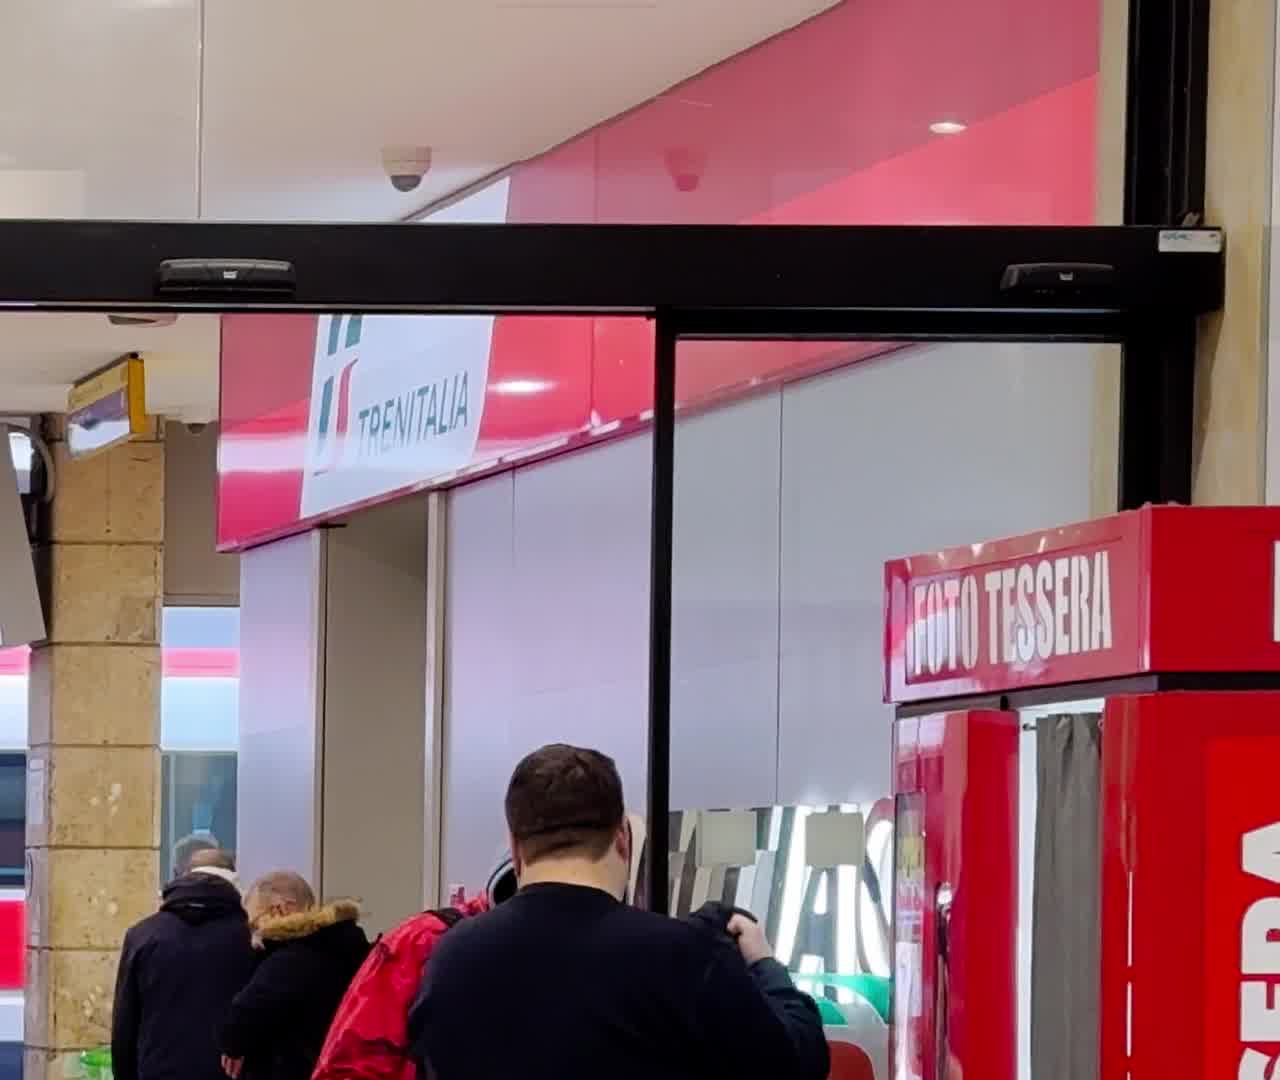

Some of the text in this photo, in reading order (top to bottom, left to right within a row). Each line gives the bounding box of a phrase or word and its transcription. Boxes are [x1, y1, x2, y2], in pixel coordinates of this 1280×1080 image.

[358, 370, 469, 456] TRENITALIA
[913, 550, 1113, 675] FOTO TESSERA
